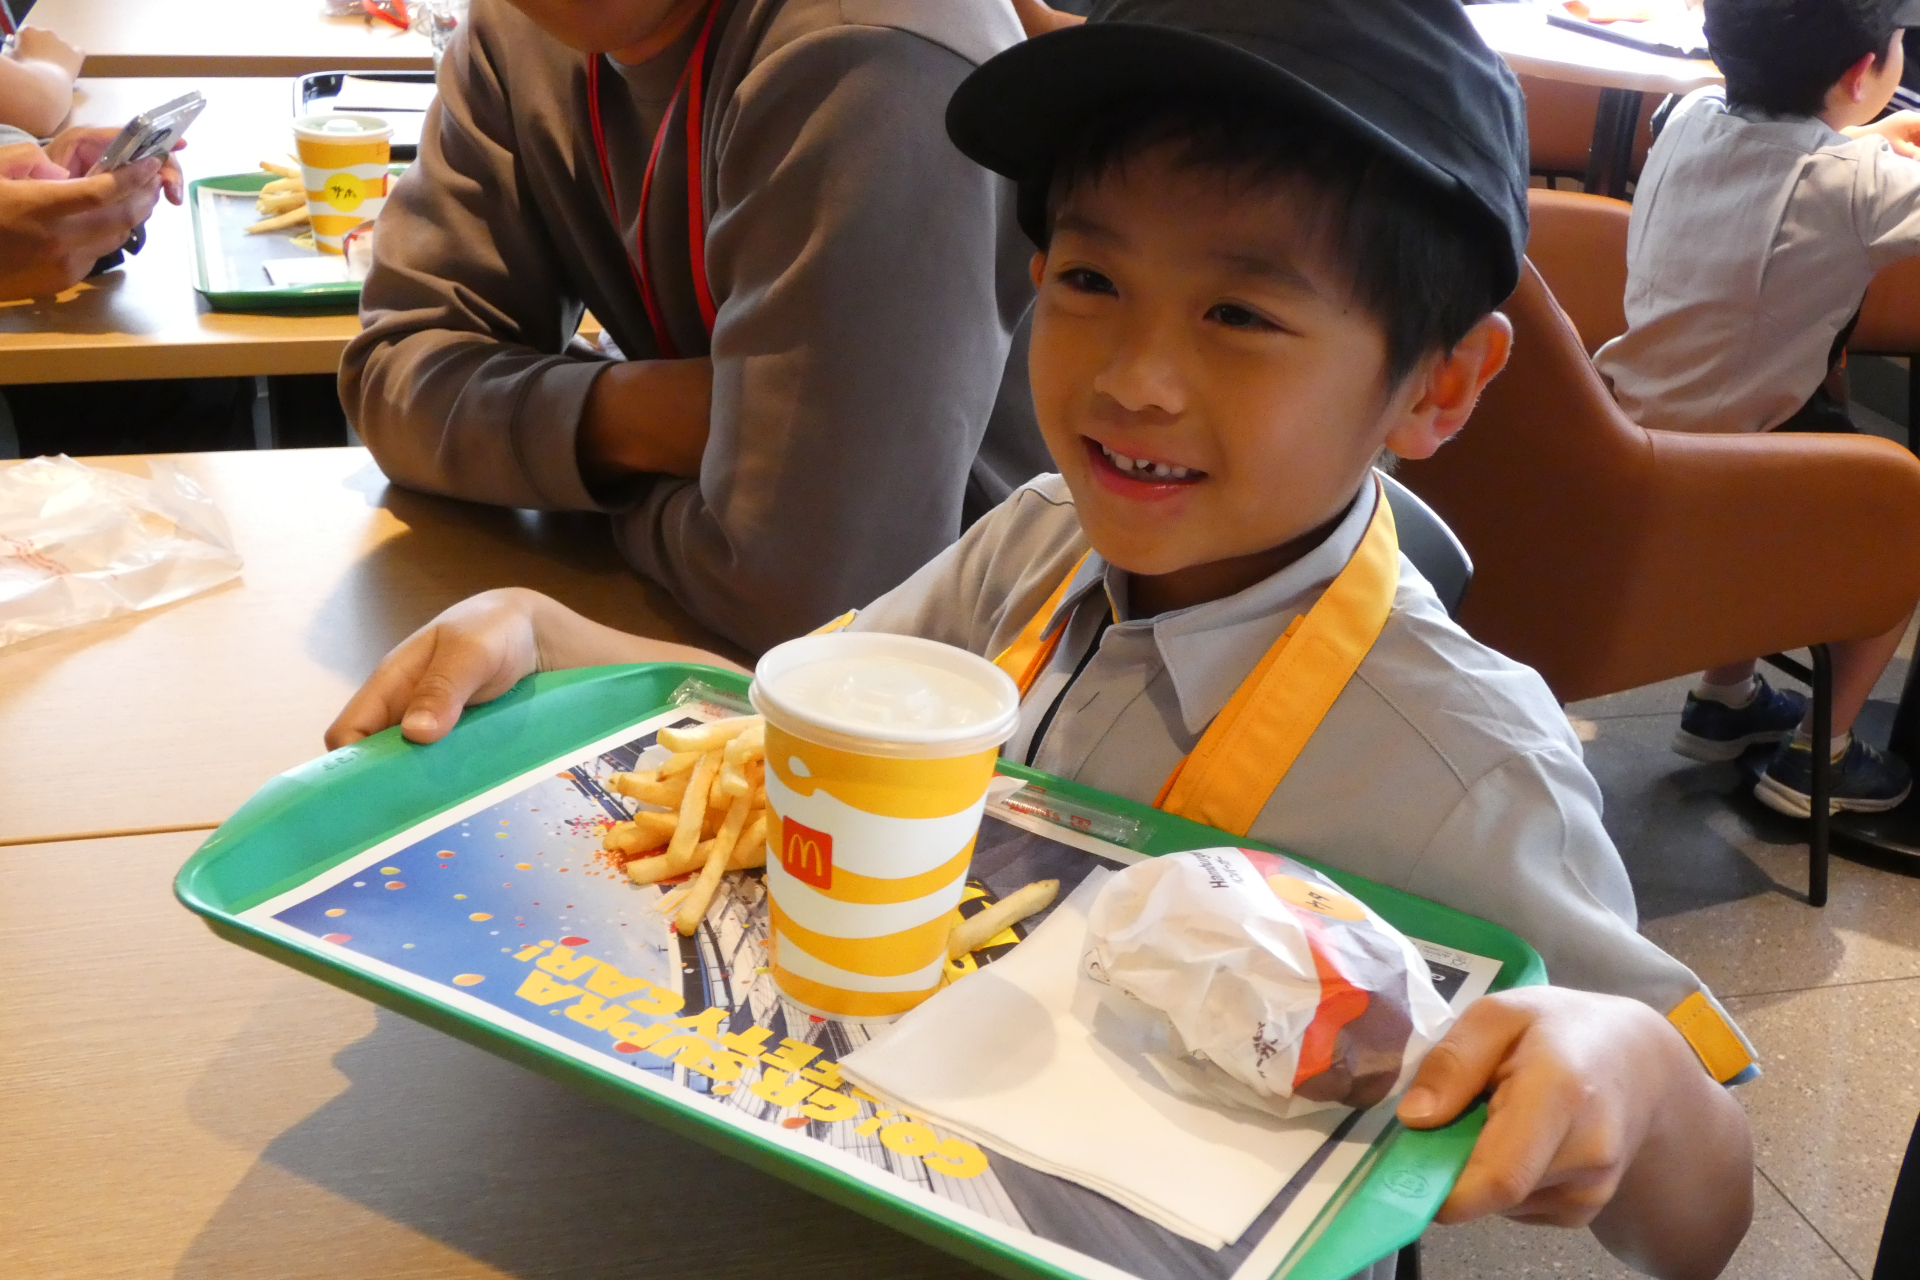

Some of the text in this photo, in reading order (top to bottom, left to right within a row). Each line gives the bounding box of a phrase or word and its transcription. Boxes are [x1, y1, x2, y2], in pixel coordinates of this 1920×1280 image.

[512, 940, 685, 1016] CAR!
[515, 969, 989, 1179] GO! GR SUPRA
